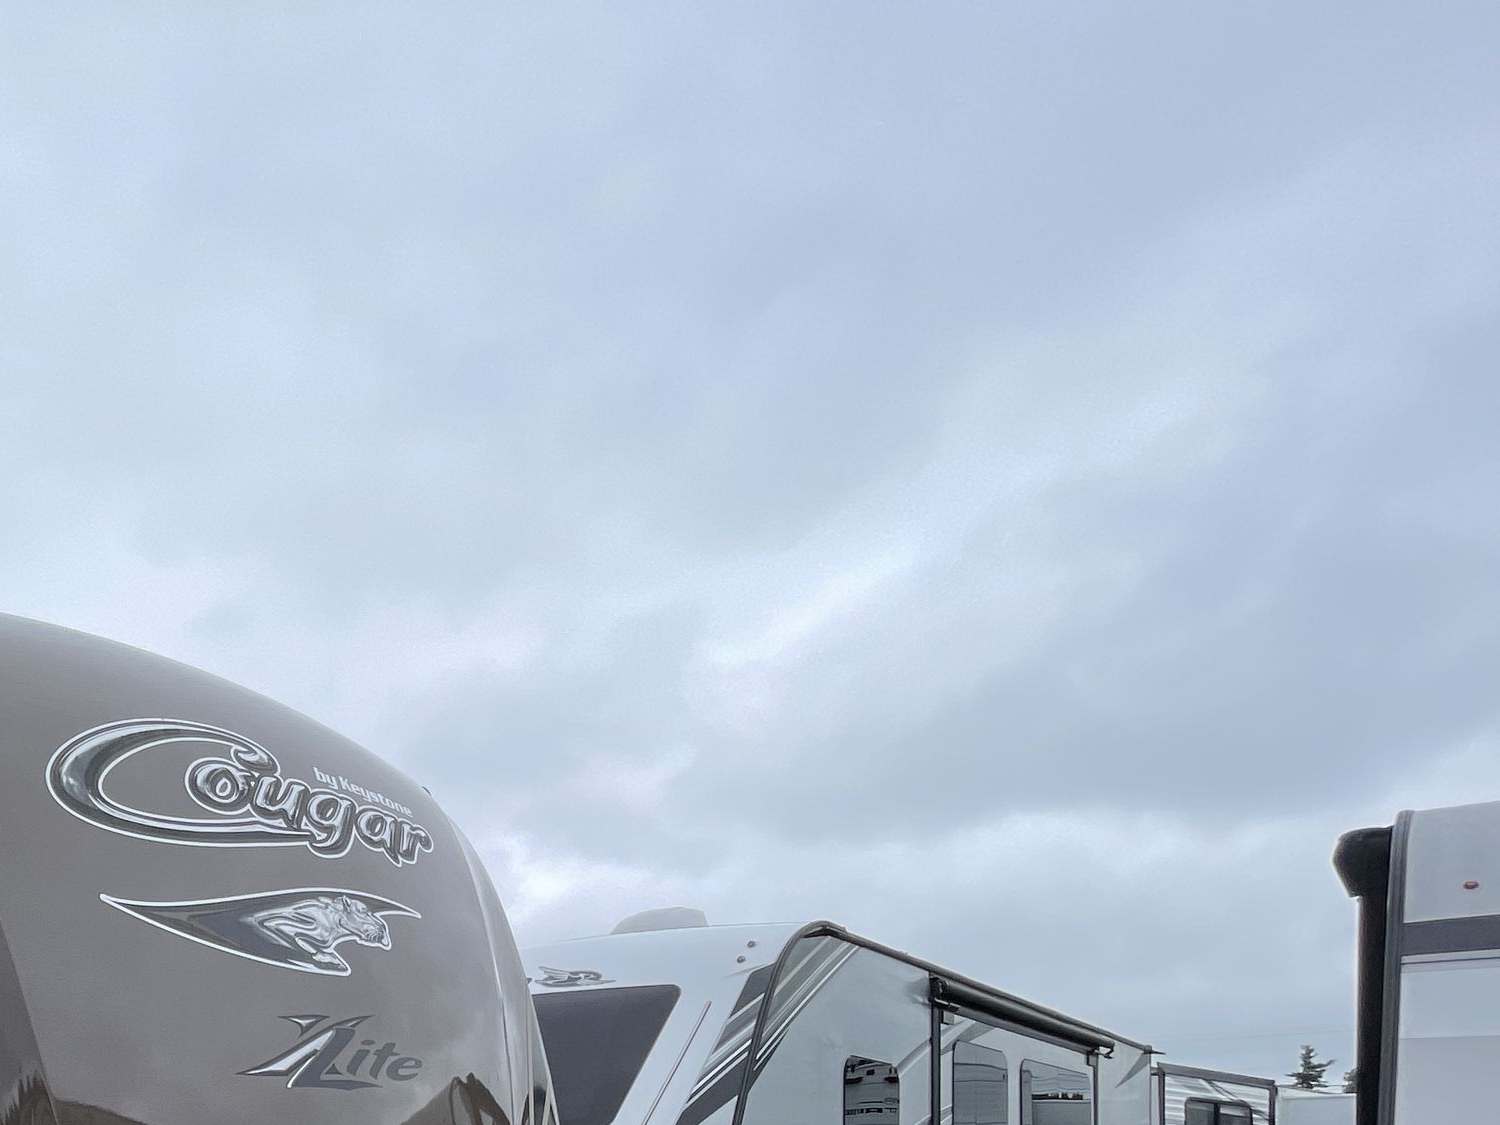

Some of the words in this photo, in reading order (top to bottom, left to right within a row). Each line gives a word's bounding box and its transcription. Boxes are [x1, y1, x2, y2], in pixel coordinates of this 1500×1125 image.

[45, 717, 435, 868] Cougar
[313, 766, 339, 790] by
[338, 775, 414, 818] Keystone
